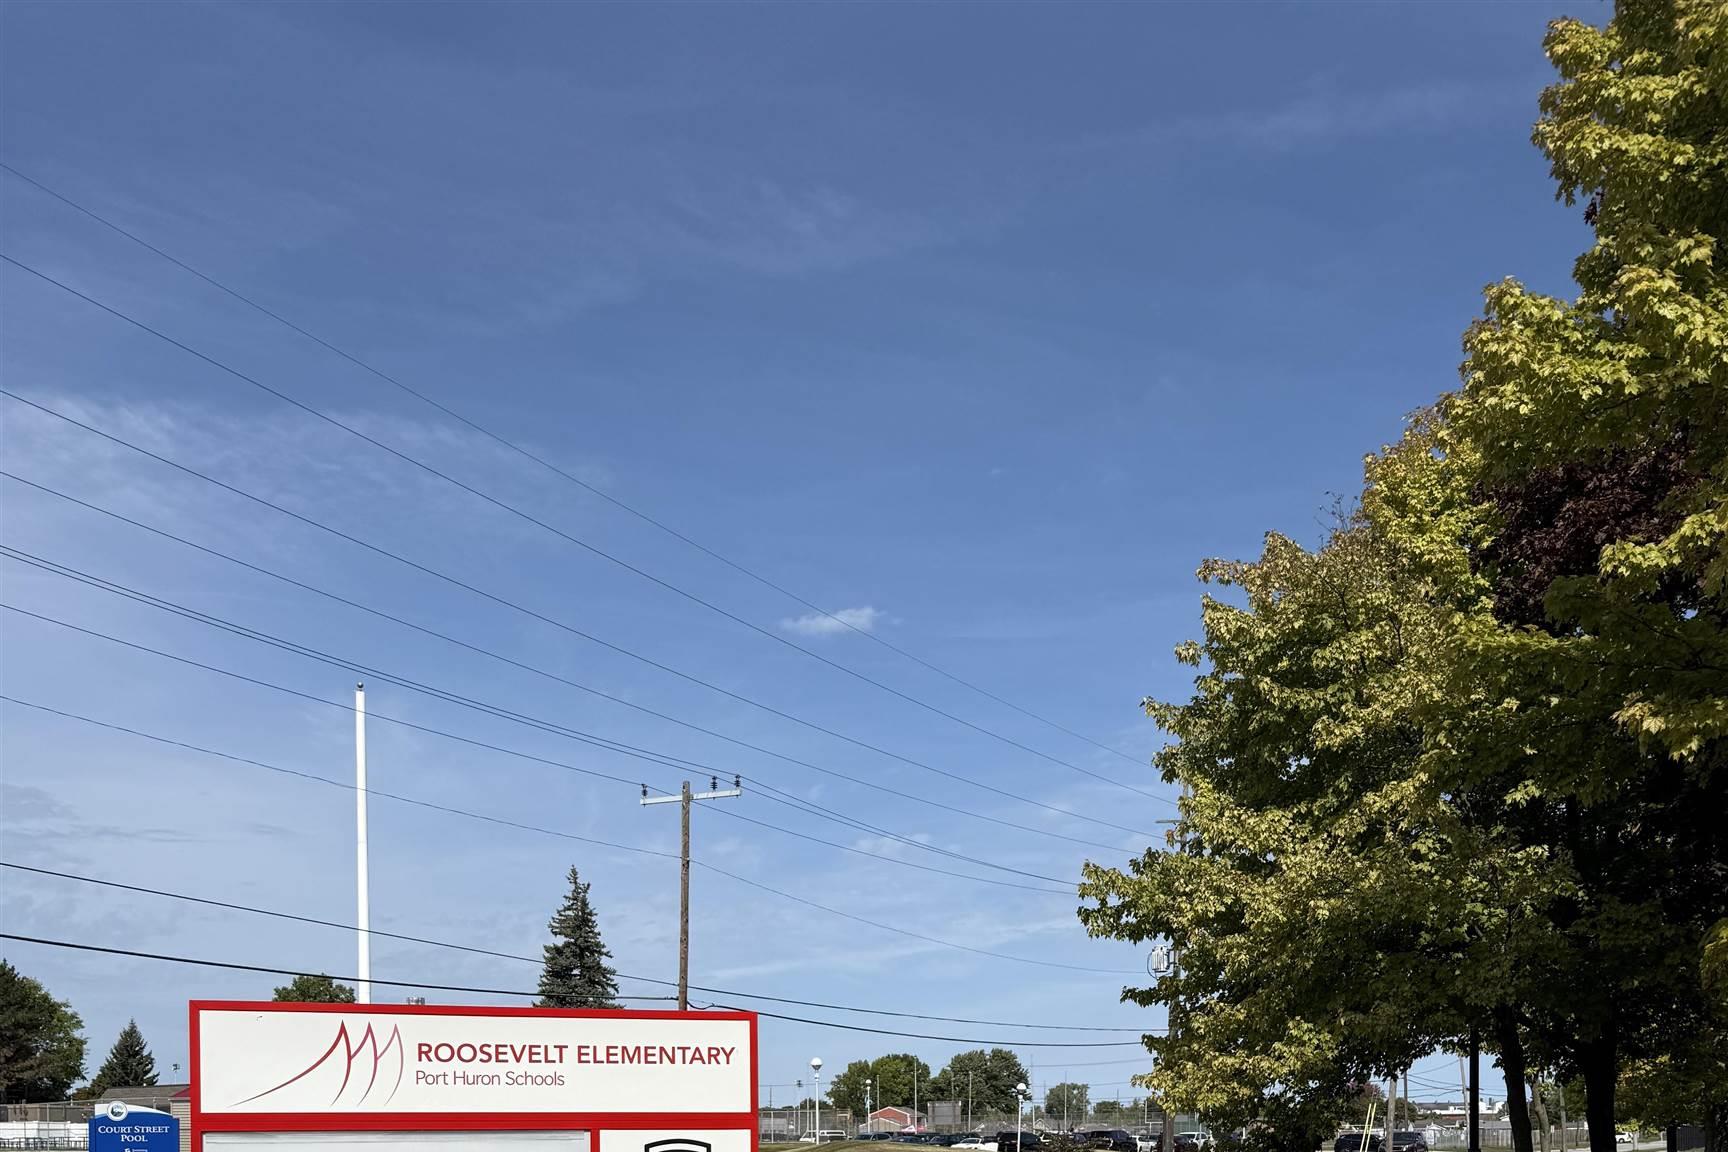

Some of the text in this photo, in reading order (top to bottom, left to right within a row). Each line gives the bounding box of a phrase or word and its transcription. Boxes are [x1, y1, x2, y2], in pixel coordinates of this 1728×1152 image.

[417, 1043, 736, 1064] ROOSEVELT ELEMENTARY
[415, 1070, 565, 1086] Port Huron Schools
[98, 1126, 170, 1134] COURT STREET
[121, 1134, 148, 1142] POOL
